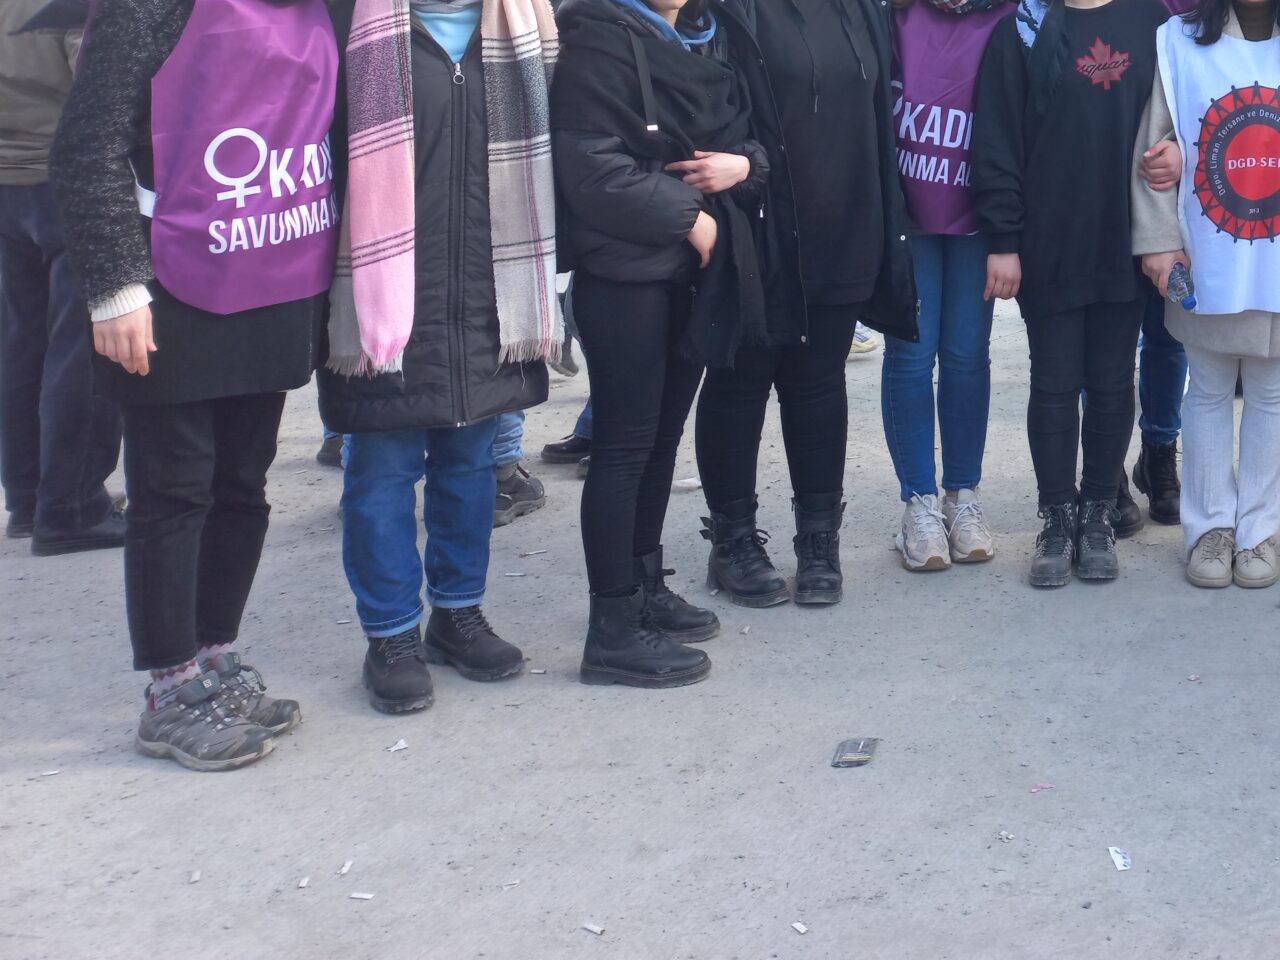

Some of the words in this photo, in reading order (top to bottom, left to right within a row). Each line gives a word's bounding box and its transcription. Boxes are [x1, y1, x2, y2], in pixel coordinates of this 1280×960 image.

[1217, 114, 1245, 139] Tersane
[1247, 109, 1257, 118] ve
[208, 197, 330, 254] SAVUNMA
